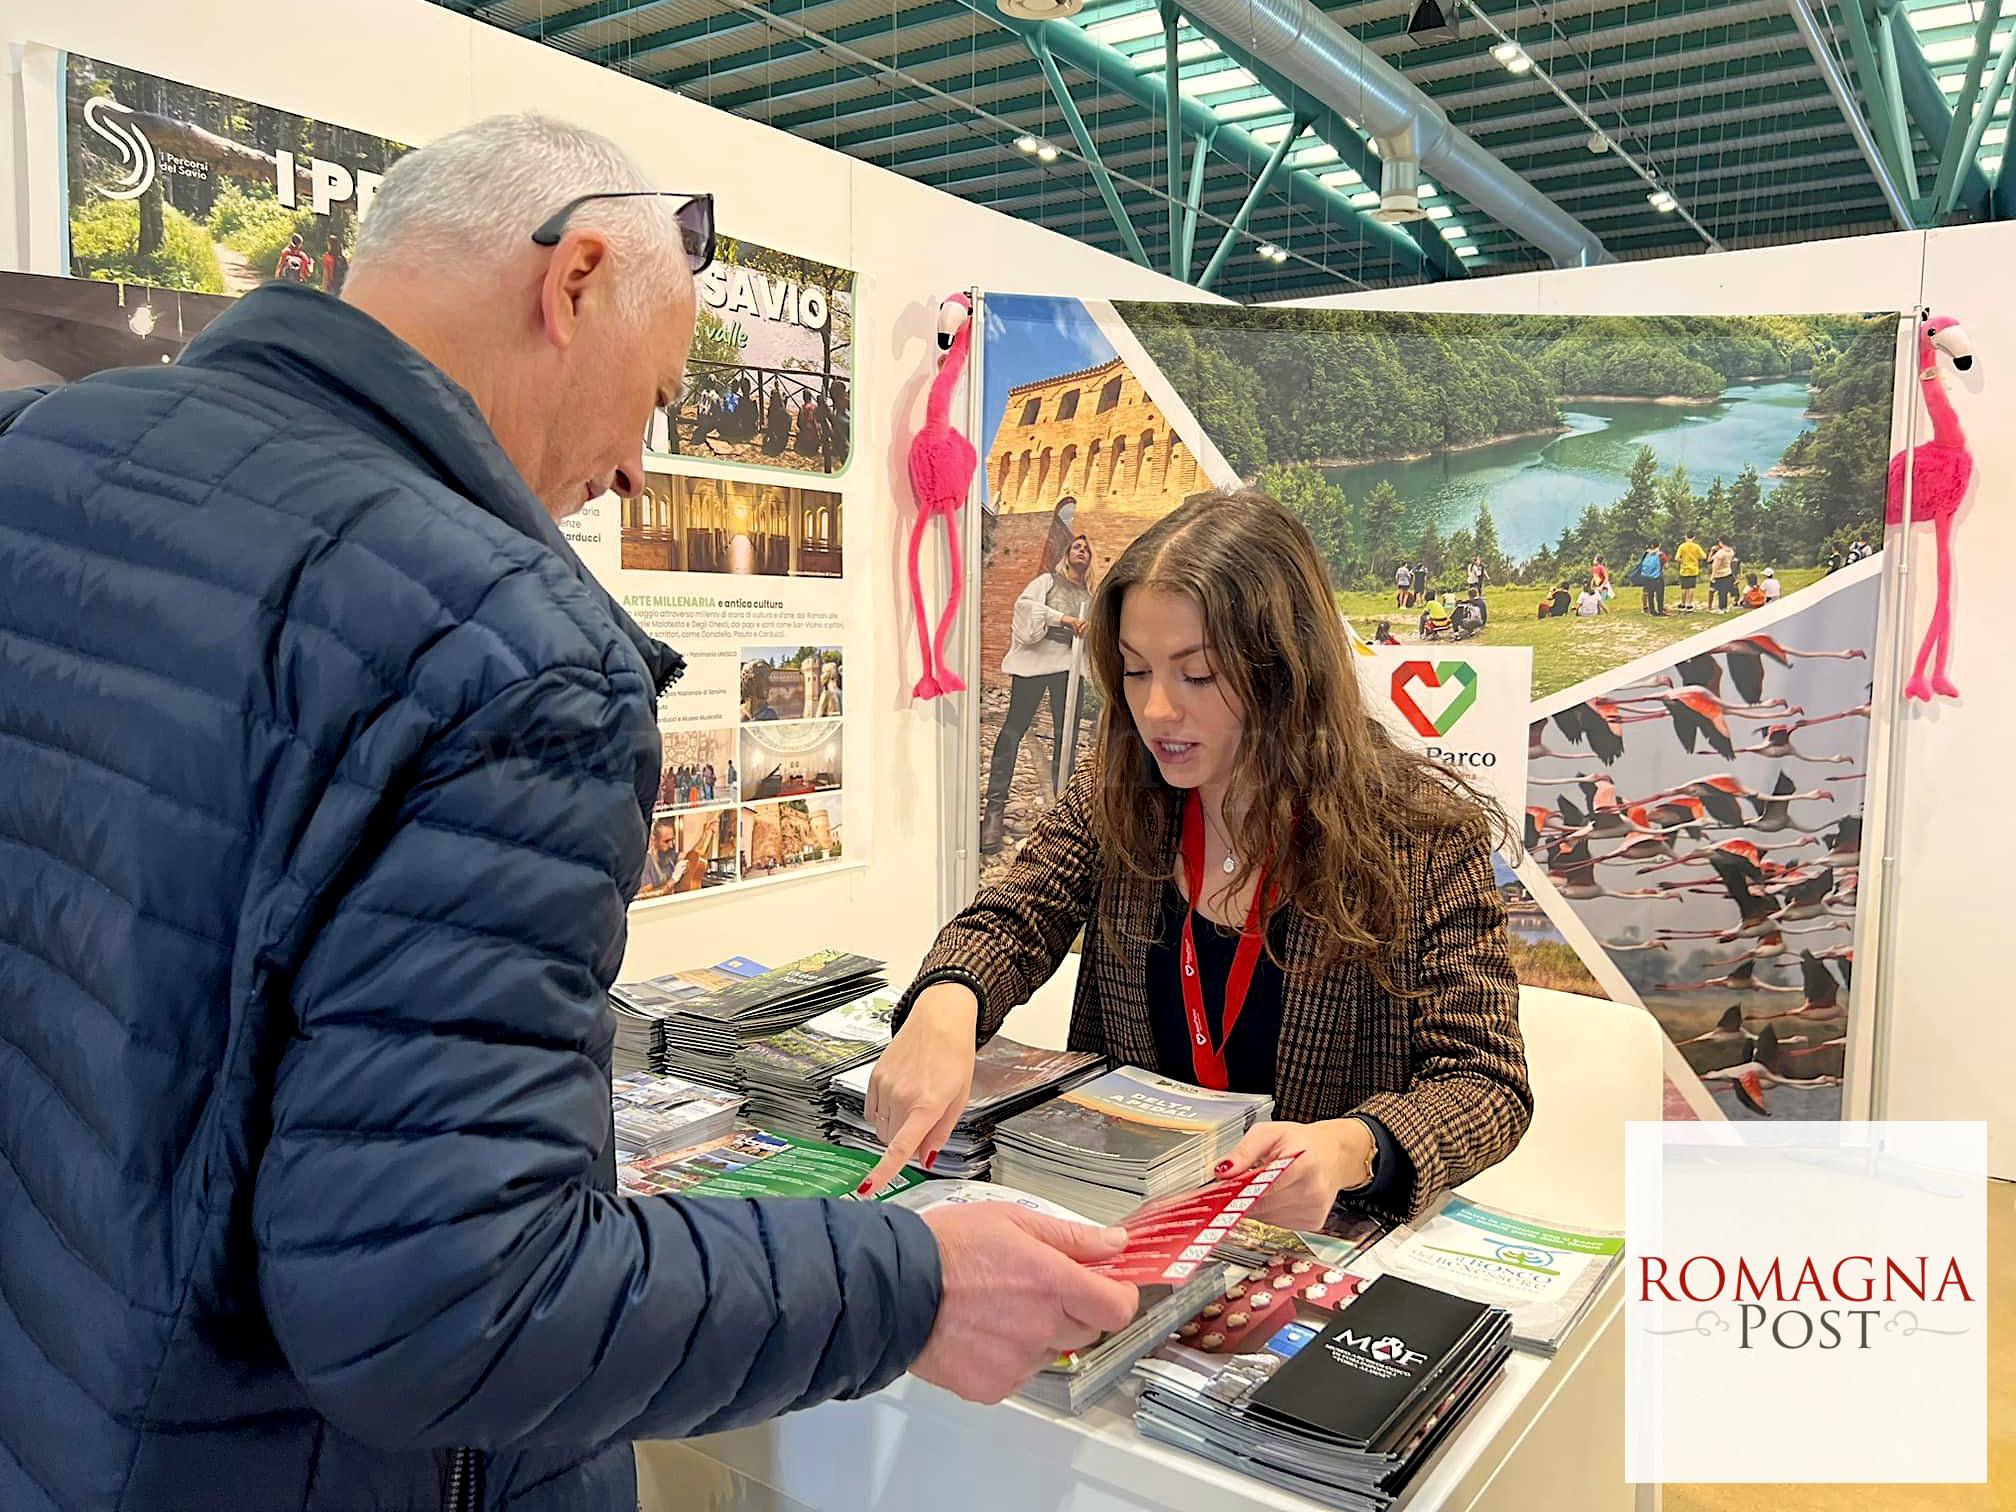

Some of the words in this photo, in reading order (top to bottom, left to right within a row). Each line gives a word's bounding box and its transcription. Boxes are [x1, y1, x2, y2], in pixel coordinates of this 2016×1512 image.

[160, 162, 177, 173] del
[178, 165, 207, 180] Savio
[167, 153, 209, 171] Percorsi
[701, 264, 828, 330] SAVIO
[706, 320, 748, 348] valle
[564, 532, 601, 543] arducci
[623, 594, 652, 607] ARTE
[653, 595, 716, 608] MILLENARIA
[724, 597, 752, 609] antica
[753, 599, 784, 609] cultura
[1426, 747, 1497, 768] Parco
[1126, 1099, 1198, 1119] PEDALI
[1131, 1092, 1194, 1112] DELTA
